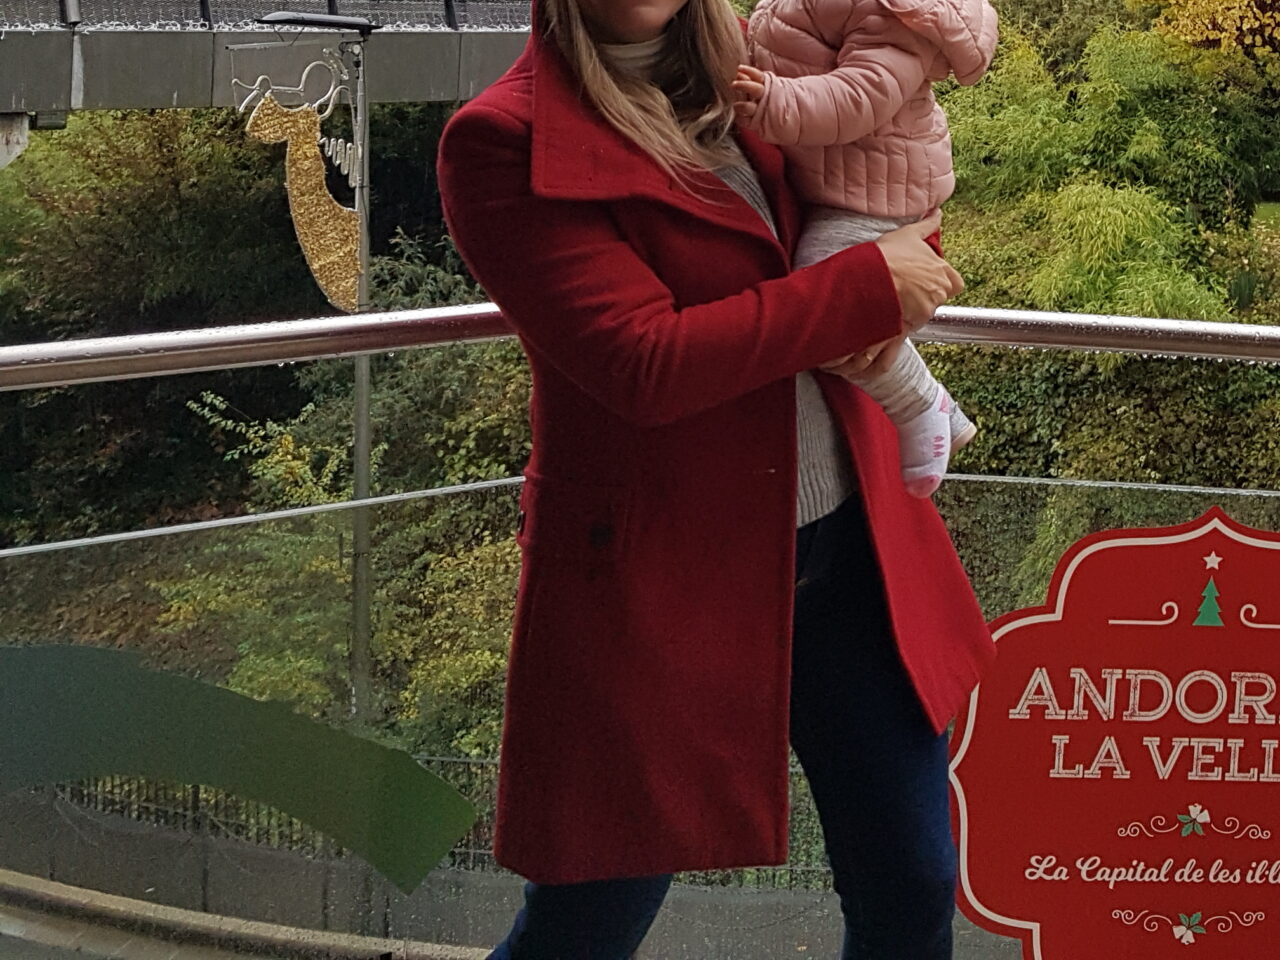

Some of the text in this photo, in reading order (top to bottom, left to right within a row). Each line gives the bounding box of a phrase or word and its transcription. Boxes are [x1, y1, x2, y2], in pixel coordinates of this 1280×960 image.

[1049, 734, 1131, 780] LA
[1025, 856, 1070, 881] La
[1075, 857, 1173, 890] Capital
[1174, 858, 1204, 883] de
[1209, 859, 1241, 884] les
